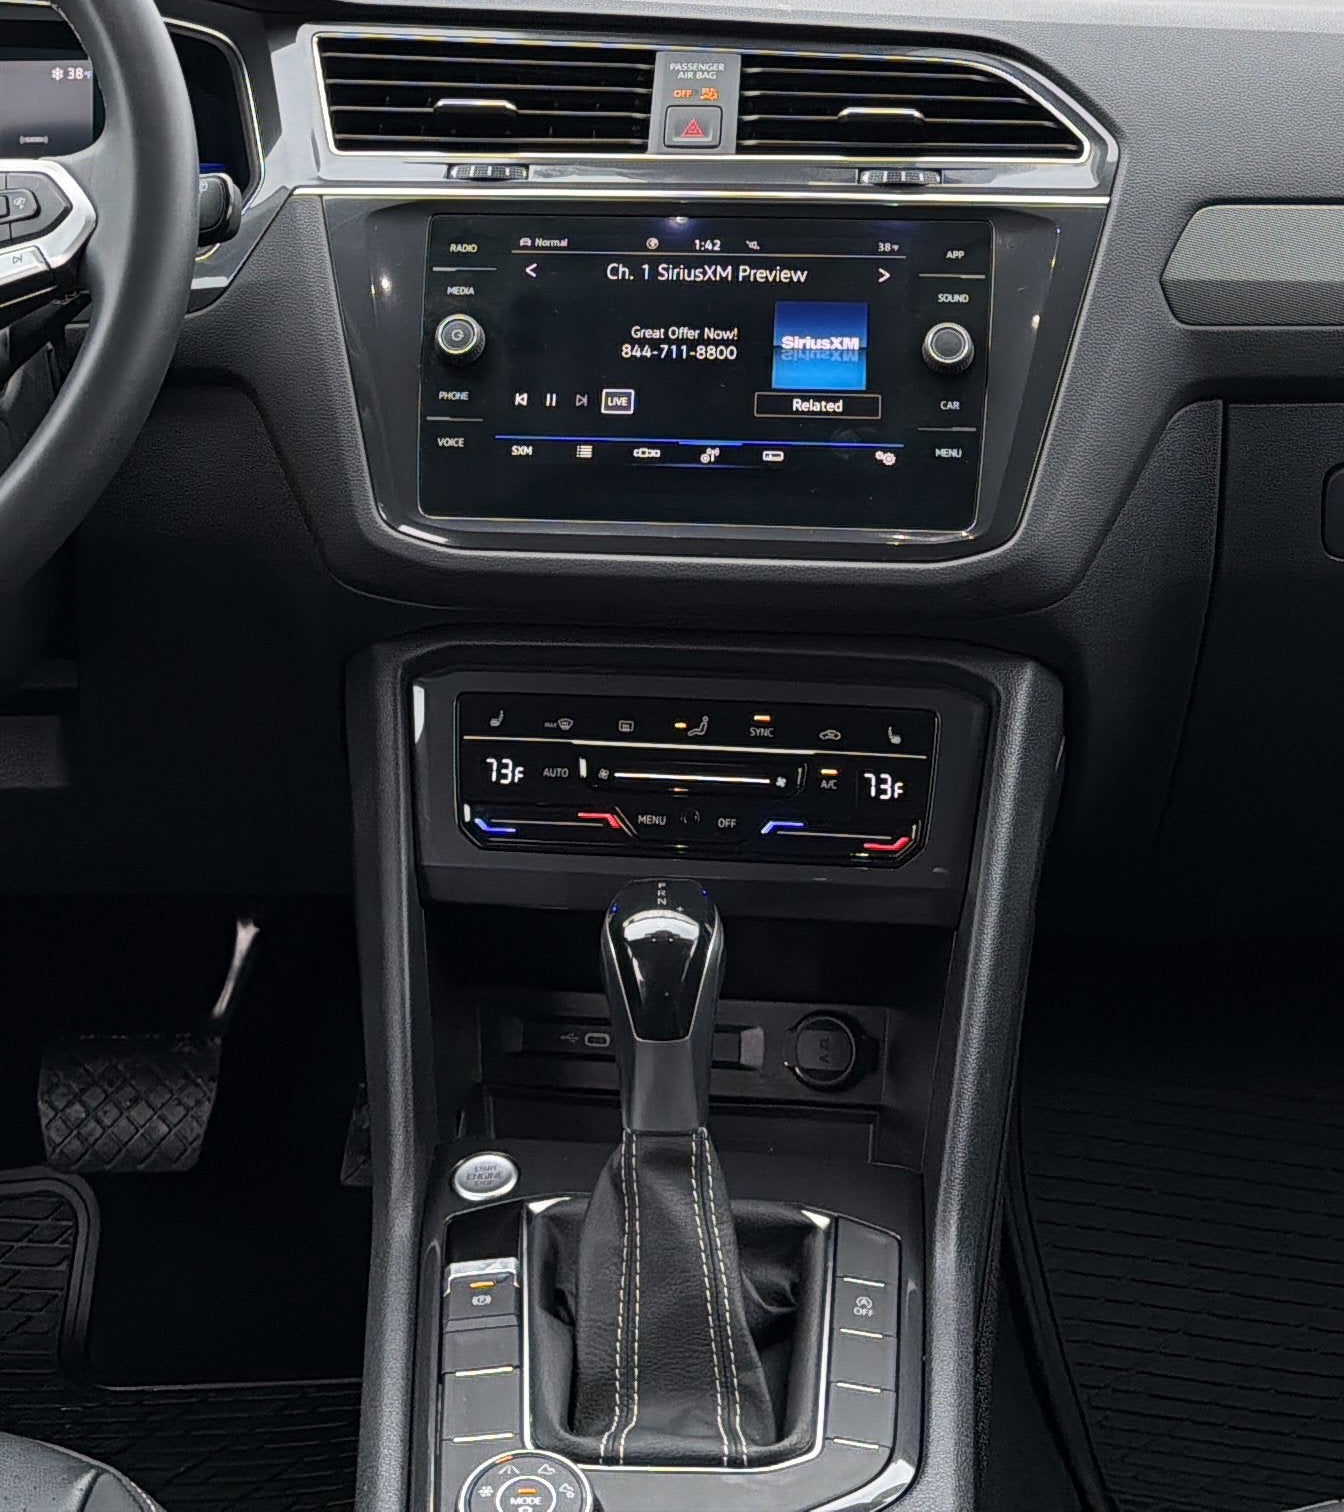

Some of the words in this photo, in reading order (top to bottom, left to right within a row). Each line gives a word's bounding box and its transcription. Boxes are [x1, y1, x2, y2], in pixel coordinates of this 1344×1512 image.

[669, 62, 725, 71] PASSENGER
[677, 71, 694, 79] AIR
[696, 71, 717, 79] BAG
[672, 89, 692, 98] OFF
[450, 243, 478, 253] RADIO
[535, 237, 568, 248] Normal
[694, 239, 721, 252] 1:42
[946, 250, 965, 260] APP
[606, 263, 634, 281] Ch.
[641, 264, 650, 280] 1
[657, 264, 732, 282] SiriusXM
[738, 265, 808, 284] Preview
[447, 286, 475, 295] MEDIA
[938, 293, 969, 303] SOUND
[631, 326, 667, 341] Great
[670, 326, 702, 341] Offer
[704, 327, 738, 341] Now!
[781, 335, 860, 351] SiriusXM
[621, 344, 738, 361] 844-711-8800
[439, 391, 469, 401] PHONE
[607, 396, 629, 407] LIVE
[792, 399, 843, 412] Related
[940, 400, 960, 411] CAR
[437, 437, 465, 448] VOICE
[511, 445, 533, 457] SXM
[935, 448, 962, 458] MENU
[750, 727, 774, 738] SYNC
[543, 768, 569, 778] AUTO
[820, 779, 838, 790] A/C
[638, 815, 667, 825] MENU
[717, 818, 737, 828] OFF
[853, 1307, 874, 1317] OFF
[510, 1496, 542, 1505] MODE
